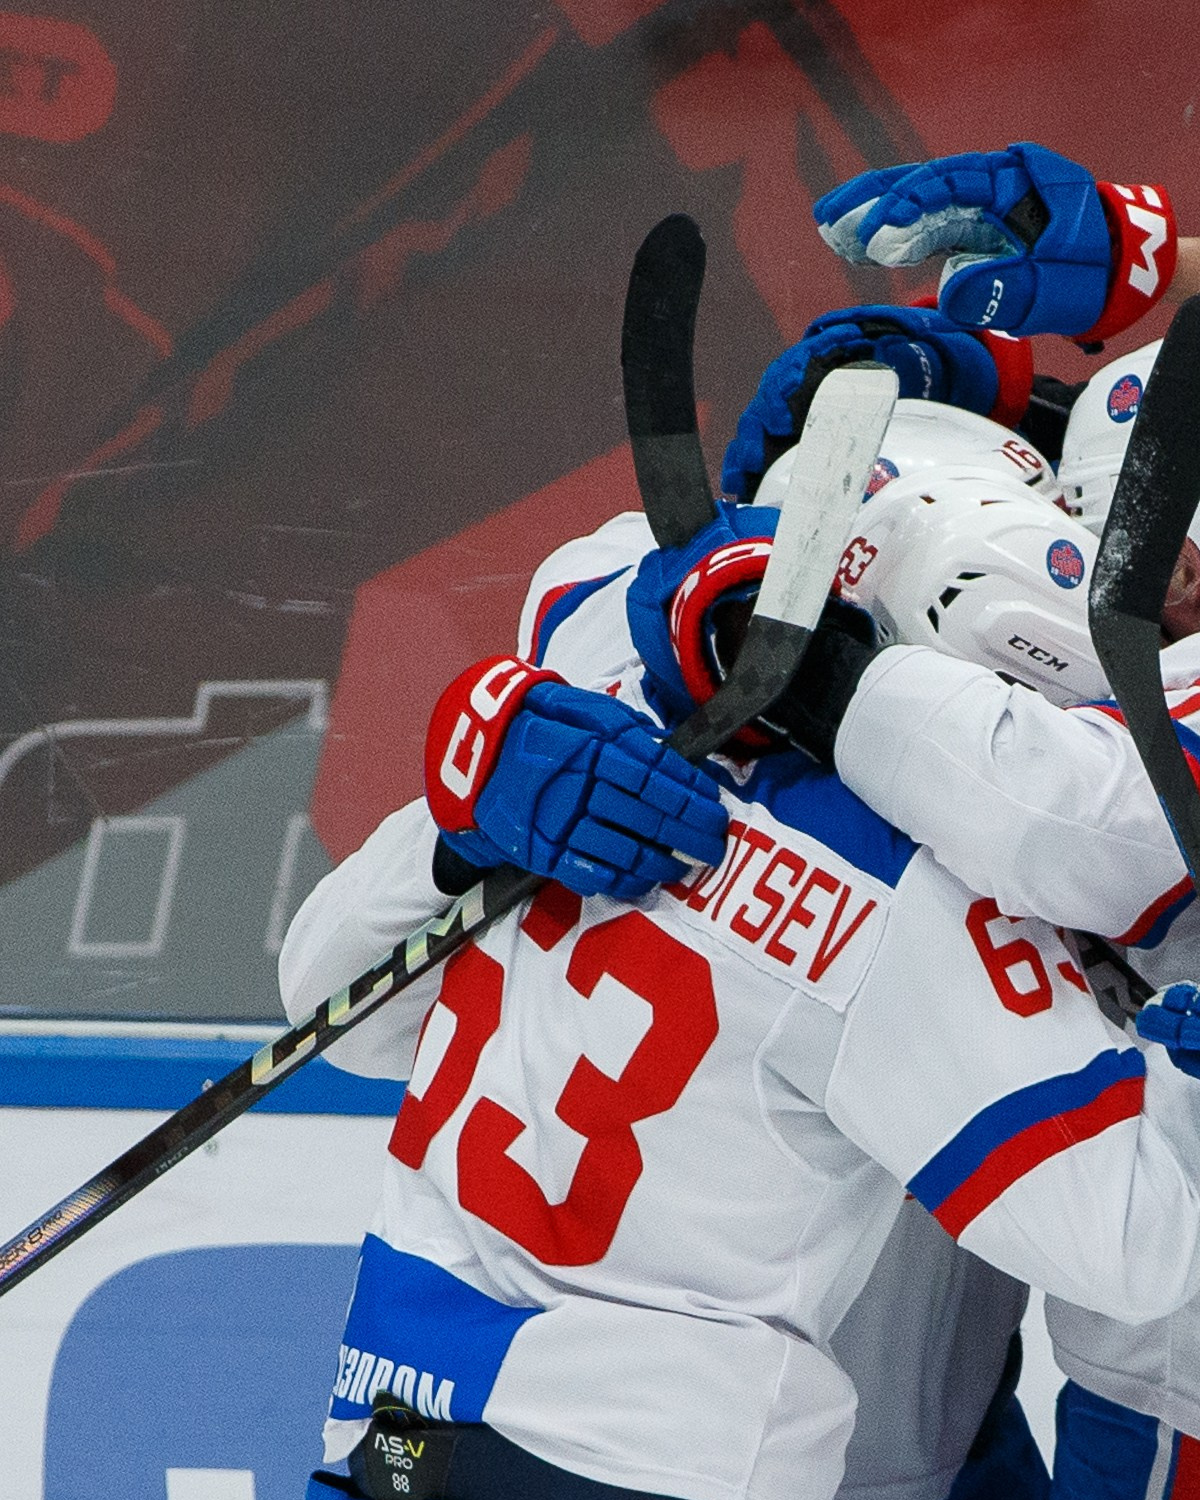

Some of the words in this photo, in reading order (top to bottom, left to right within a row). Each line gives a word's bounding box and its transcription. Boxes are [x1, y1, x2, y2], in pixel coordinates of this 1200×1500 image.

[1008, 634, 1069, 672] CCM
[252, 882, 486, 1085] CCM
[385, 1453, 414, 1470] PRO
[392, 1472, 410, 1494] 88
